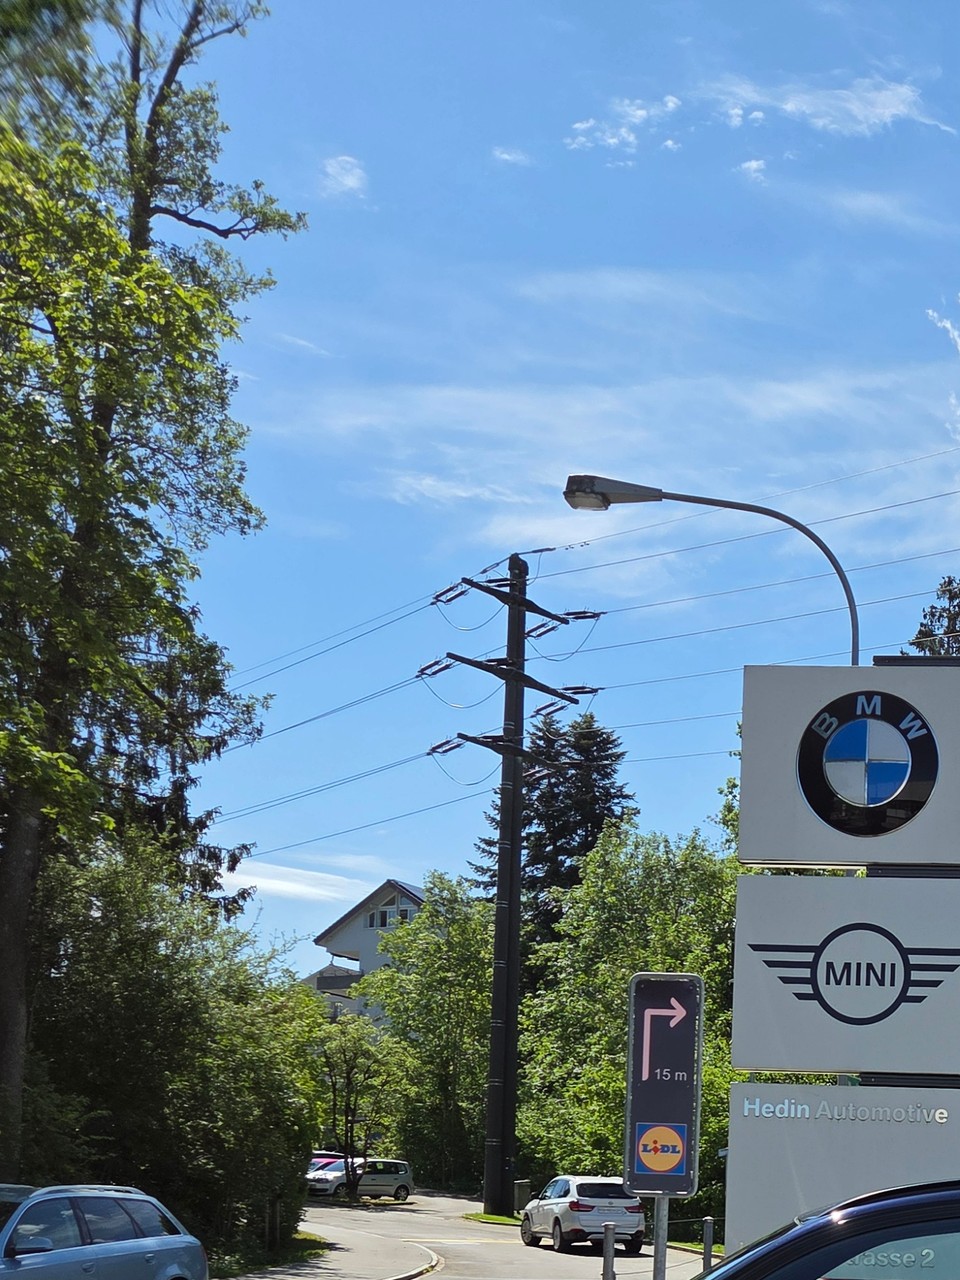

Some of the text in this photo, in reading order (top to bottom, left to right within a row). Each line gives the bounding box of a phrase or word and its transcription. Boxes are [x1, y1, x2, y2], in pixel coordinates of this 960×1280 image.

[811, 694, 928, 741] BMW
[825, 961, 896, 987] MINI
[654, 1068, 688, 1081] 15 m
[743, 1097, 949, 1124] Hedin Automotive
[847, 1248, 936, 1268] rasse 2
